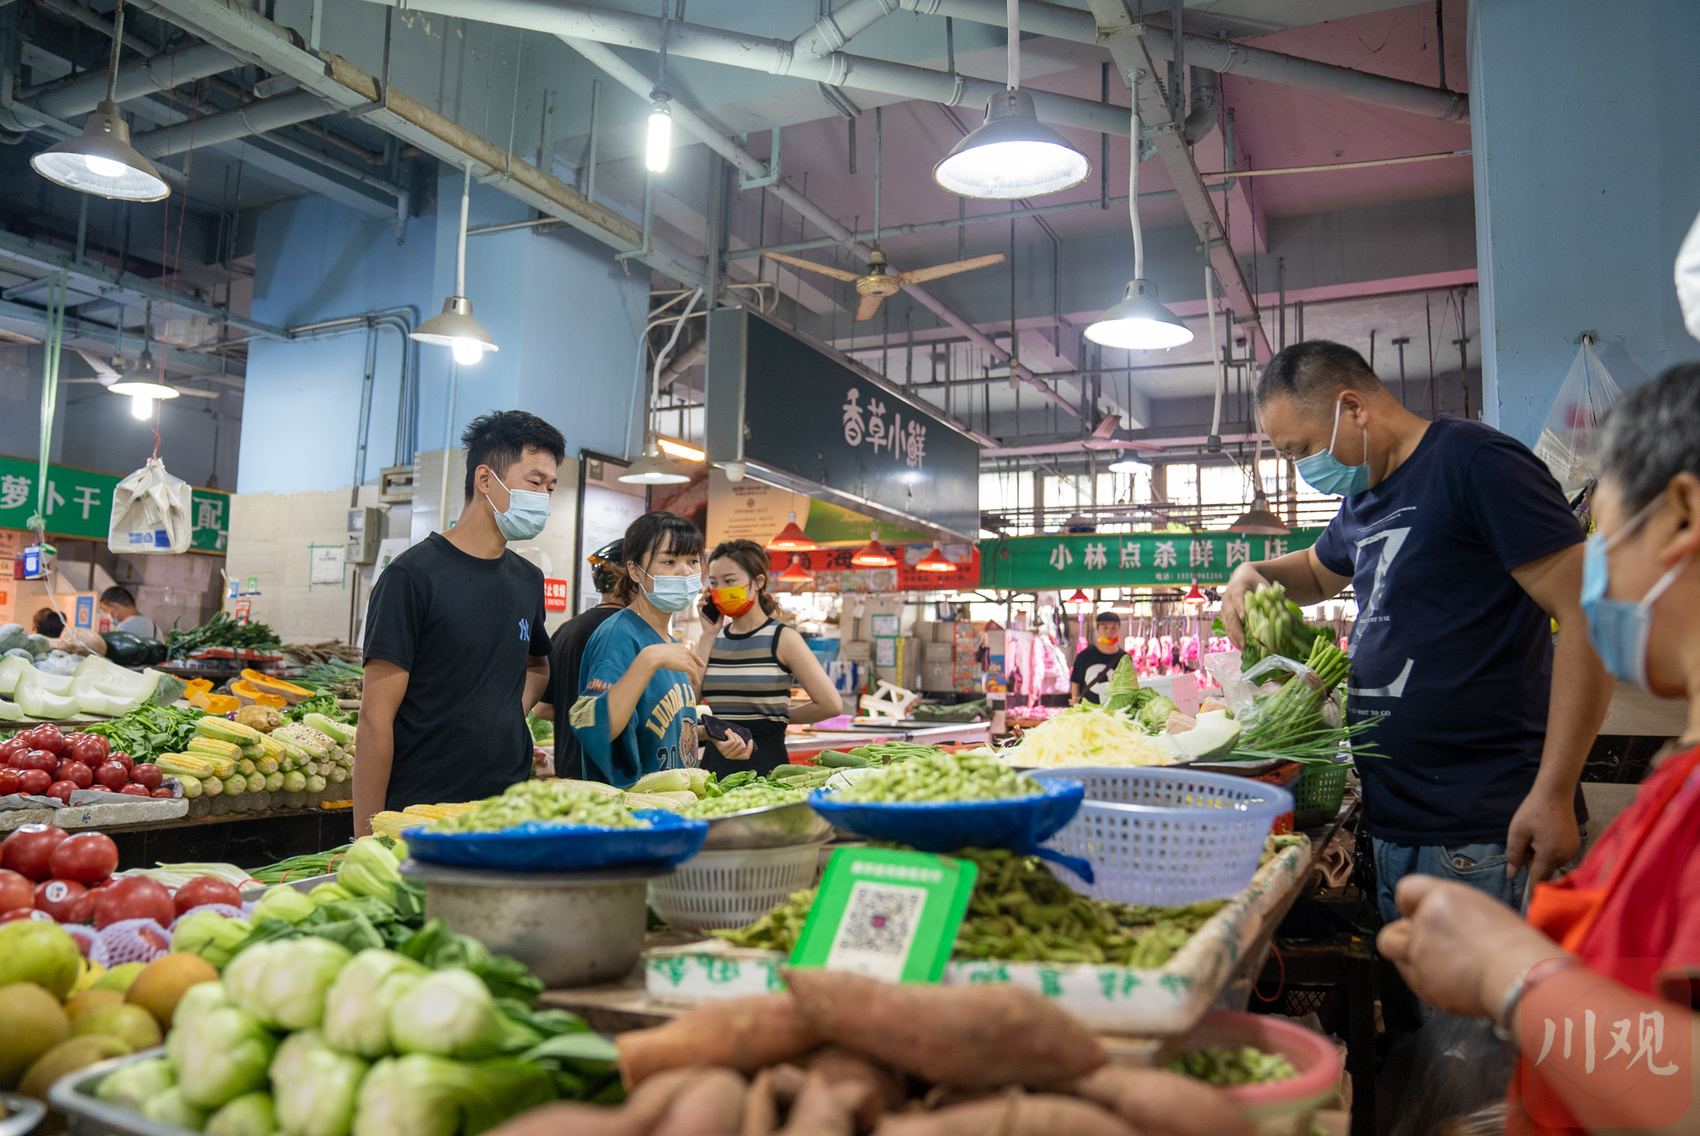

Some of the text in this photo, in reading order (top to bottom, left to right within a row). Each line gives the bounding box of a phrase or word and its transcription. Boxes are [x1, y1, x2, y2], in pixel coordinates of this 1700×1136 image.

[1050, 538, 1289, 571] 小林点杀鲜肉店
[518, 618, 530, 642] NY
